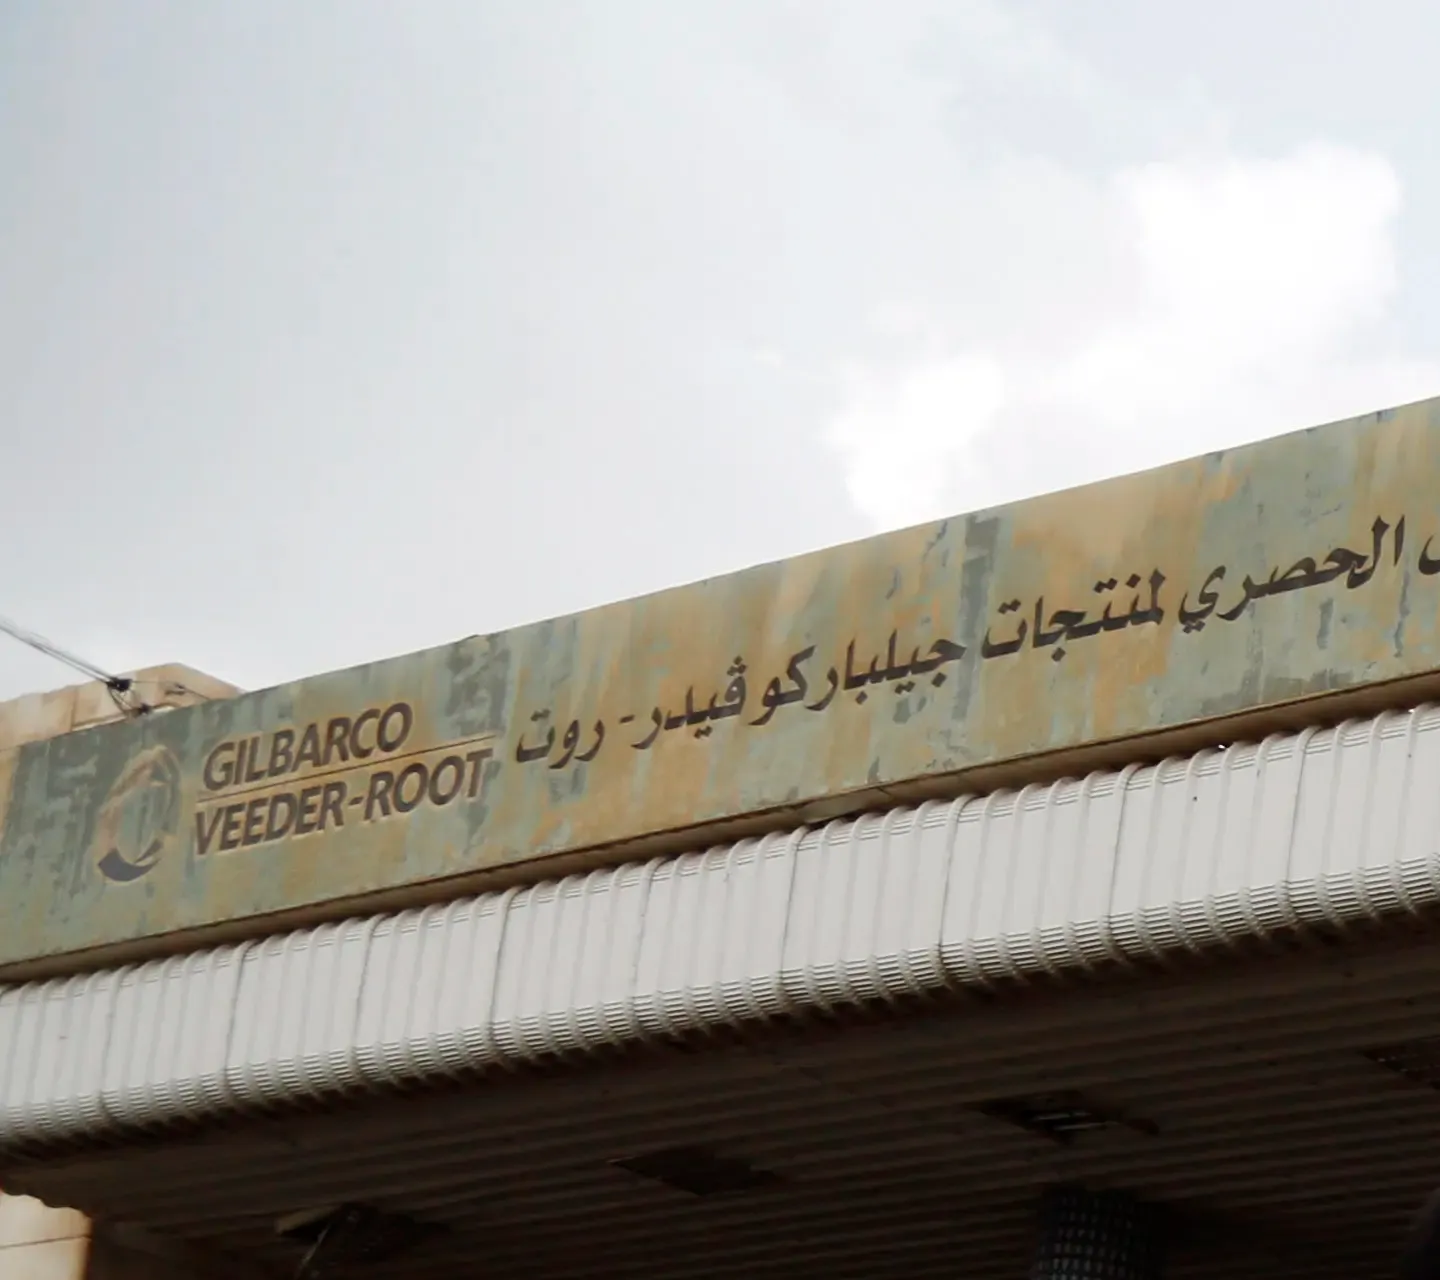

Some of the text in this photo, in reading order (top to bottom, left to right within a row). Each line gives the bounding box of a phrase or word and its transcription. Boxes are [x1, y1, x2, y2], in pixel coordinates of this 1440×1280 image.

[980, 568, 1165, 661] لمنتجات
[1176, 513, 1405, 633] الحصري
[203, 701, 413, 792] GILBARCO
[194, 748, 495, 857] VEEDER-ROOT
